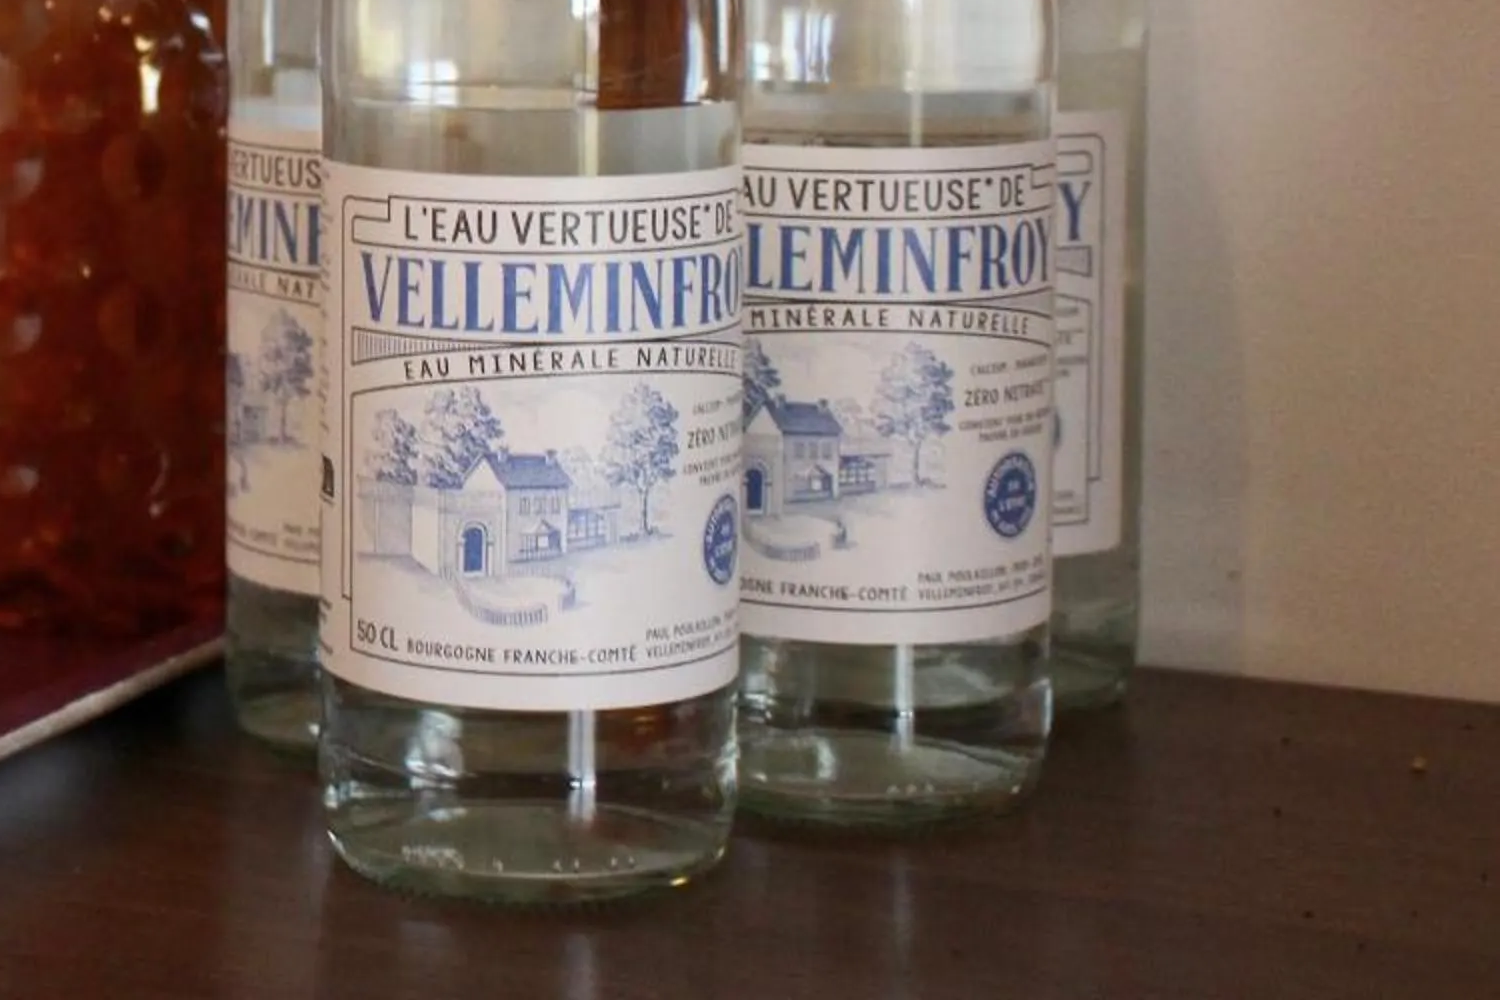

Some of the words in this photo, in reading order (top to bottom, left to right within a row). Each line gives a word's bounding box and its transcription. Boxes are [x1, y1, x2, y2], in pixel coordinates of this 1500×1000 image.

[1000, 174, 1025, 208] DE
[405, 204, 498, 245] L'EAU
[715, 200, 734, 236] DE
[751, 302, 890, 328] MINÉRALE
[908, 308, 1029, 335] NATURELLE
[404, 355, 450, 381] EAU
[469, 346, 620, 376] MINÉRALE
[637, 346, 736, 370] NATURELLE
[356, 619, 377, 643] 50
[380, 626, 399, 652] CL
[407, 638, 495, 663] BOURGOGNE
[503, 644, 637, 665] FRANCHE-COMTÉ
